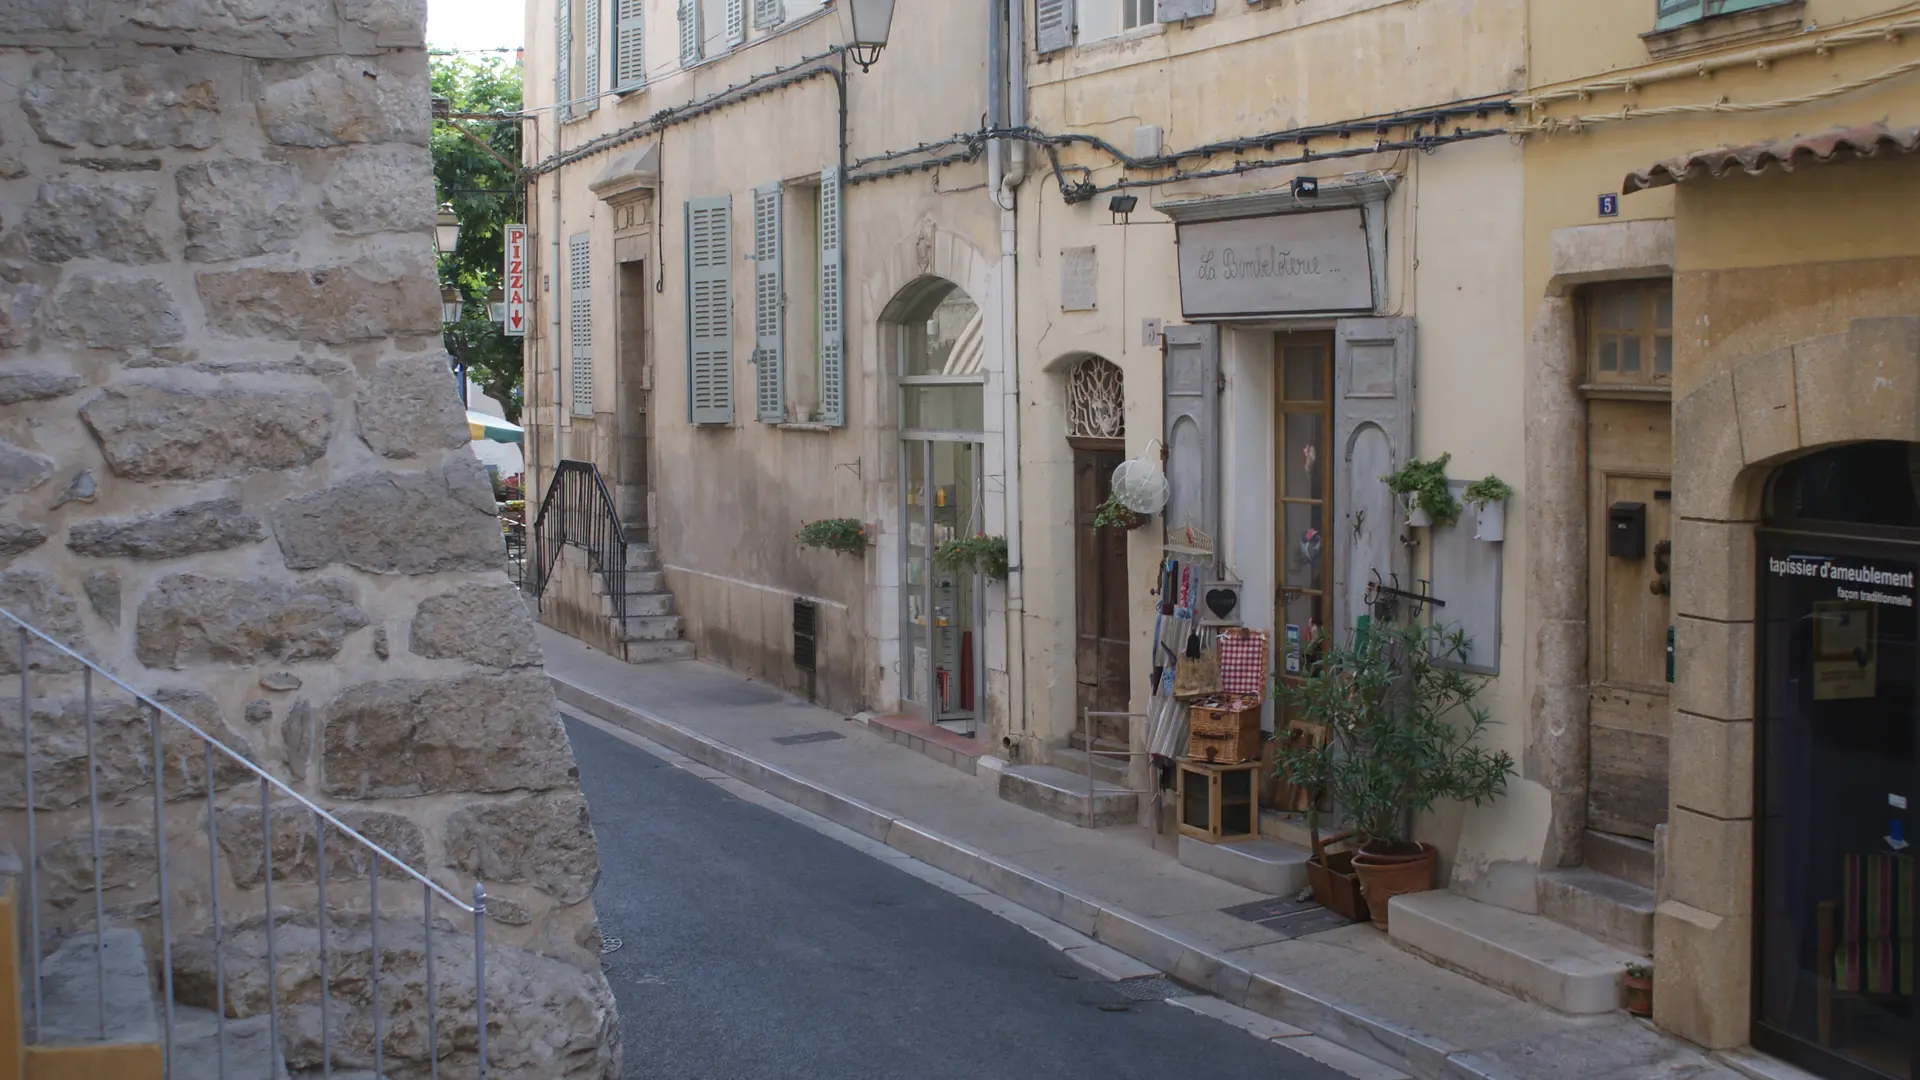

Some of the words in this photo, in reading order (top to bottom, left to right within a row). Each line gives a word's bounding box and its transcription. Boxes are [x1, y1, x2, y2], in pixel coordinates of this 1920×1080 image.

[1603, 197, 1612, 213] 5
[510, 230, 524, 304] PIZZA
[1198, 250, 1217, 281] La
[1769, 556, 1818, 577] tapissier
[1819, 561, 1914, 588] d'ameublement
[1837, 586, 1859, 601] façon
[1860, 591, 1913, 607] traditionnelle
